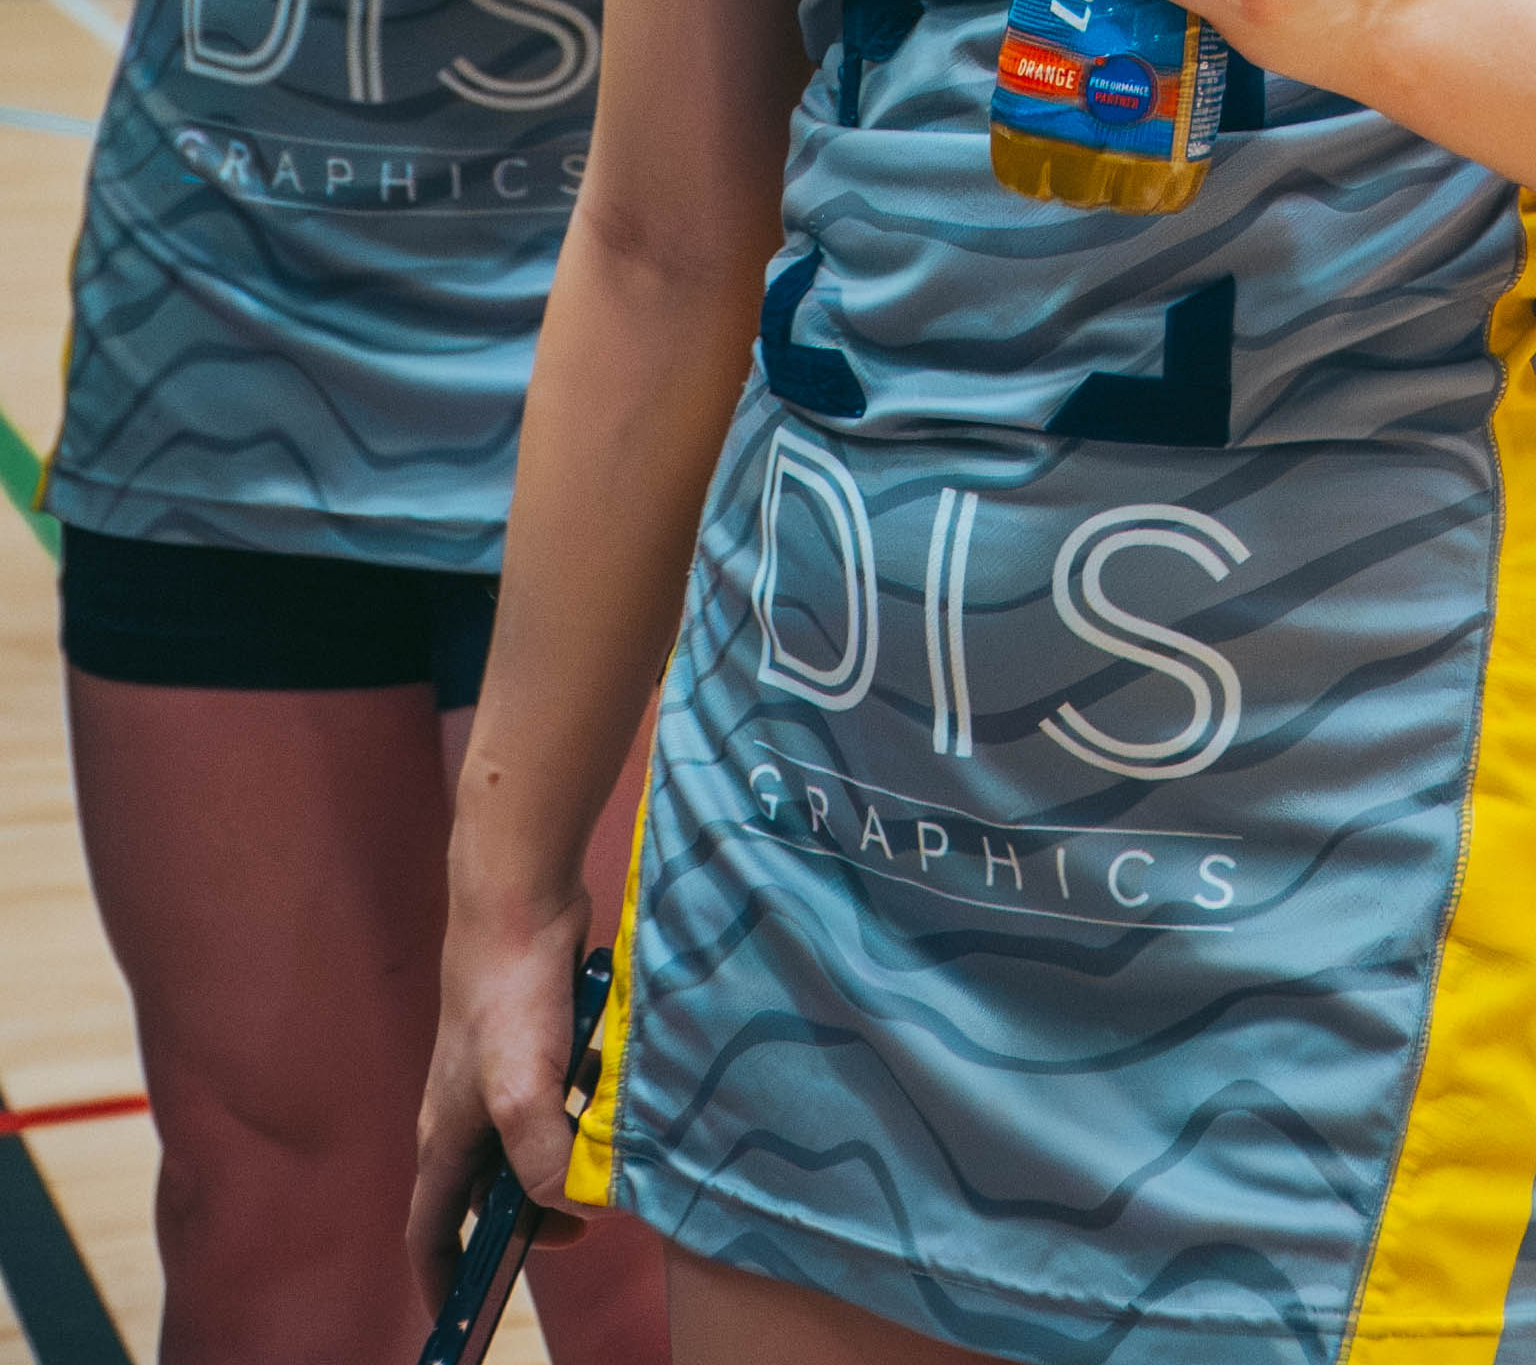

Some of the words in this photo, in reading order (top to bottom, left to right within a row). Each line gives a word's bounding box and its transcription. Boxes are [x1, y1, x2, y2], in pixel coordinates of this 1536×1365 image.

[1016, 57, 1077, 90] ORANGE
[1089, 75, 1150, 98] PERFORMANCE
[174, 127, 588, 203] GRAPHICS
[751, 426, 1250, 780] DIS
[746, 761, 1237, 912] GRAPHICS
